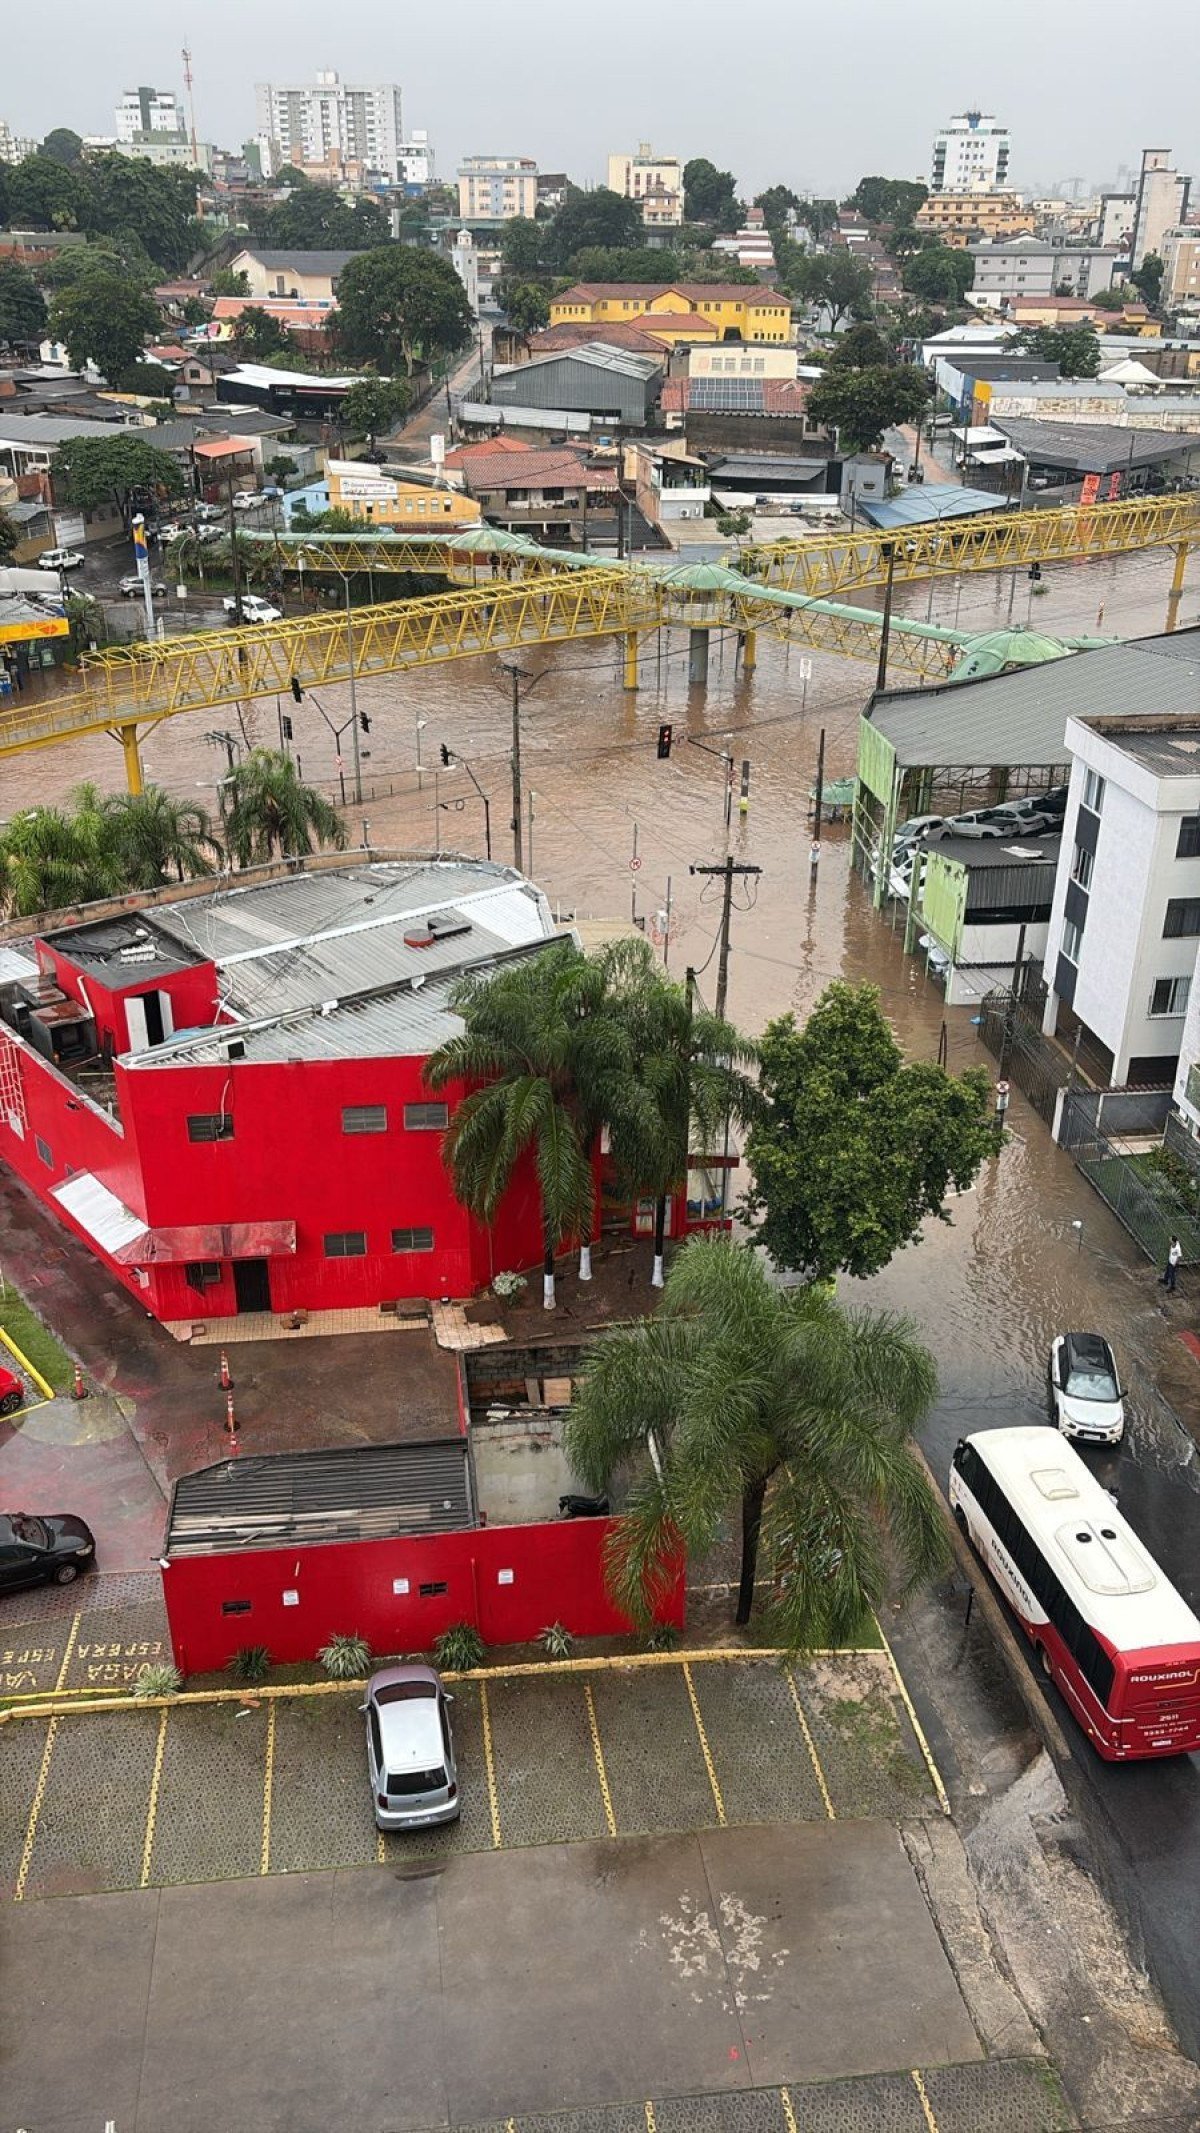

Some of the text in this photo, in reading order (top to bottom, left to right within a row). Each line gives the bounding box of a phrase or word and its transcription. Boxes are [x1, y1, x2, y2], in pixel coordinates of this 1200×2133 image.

[77, 1641, 163, 1659] ESPERA
[0, 1670, 37, 1690] VA
[1130, 1670, 1194, 1682] ROUXINOL
